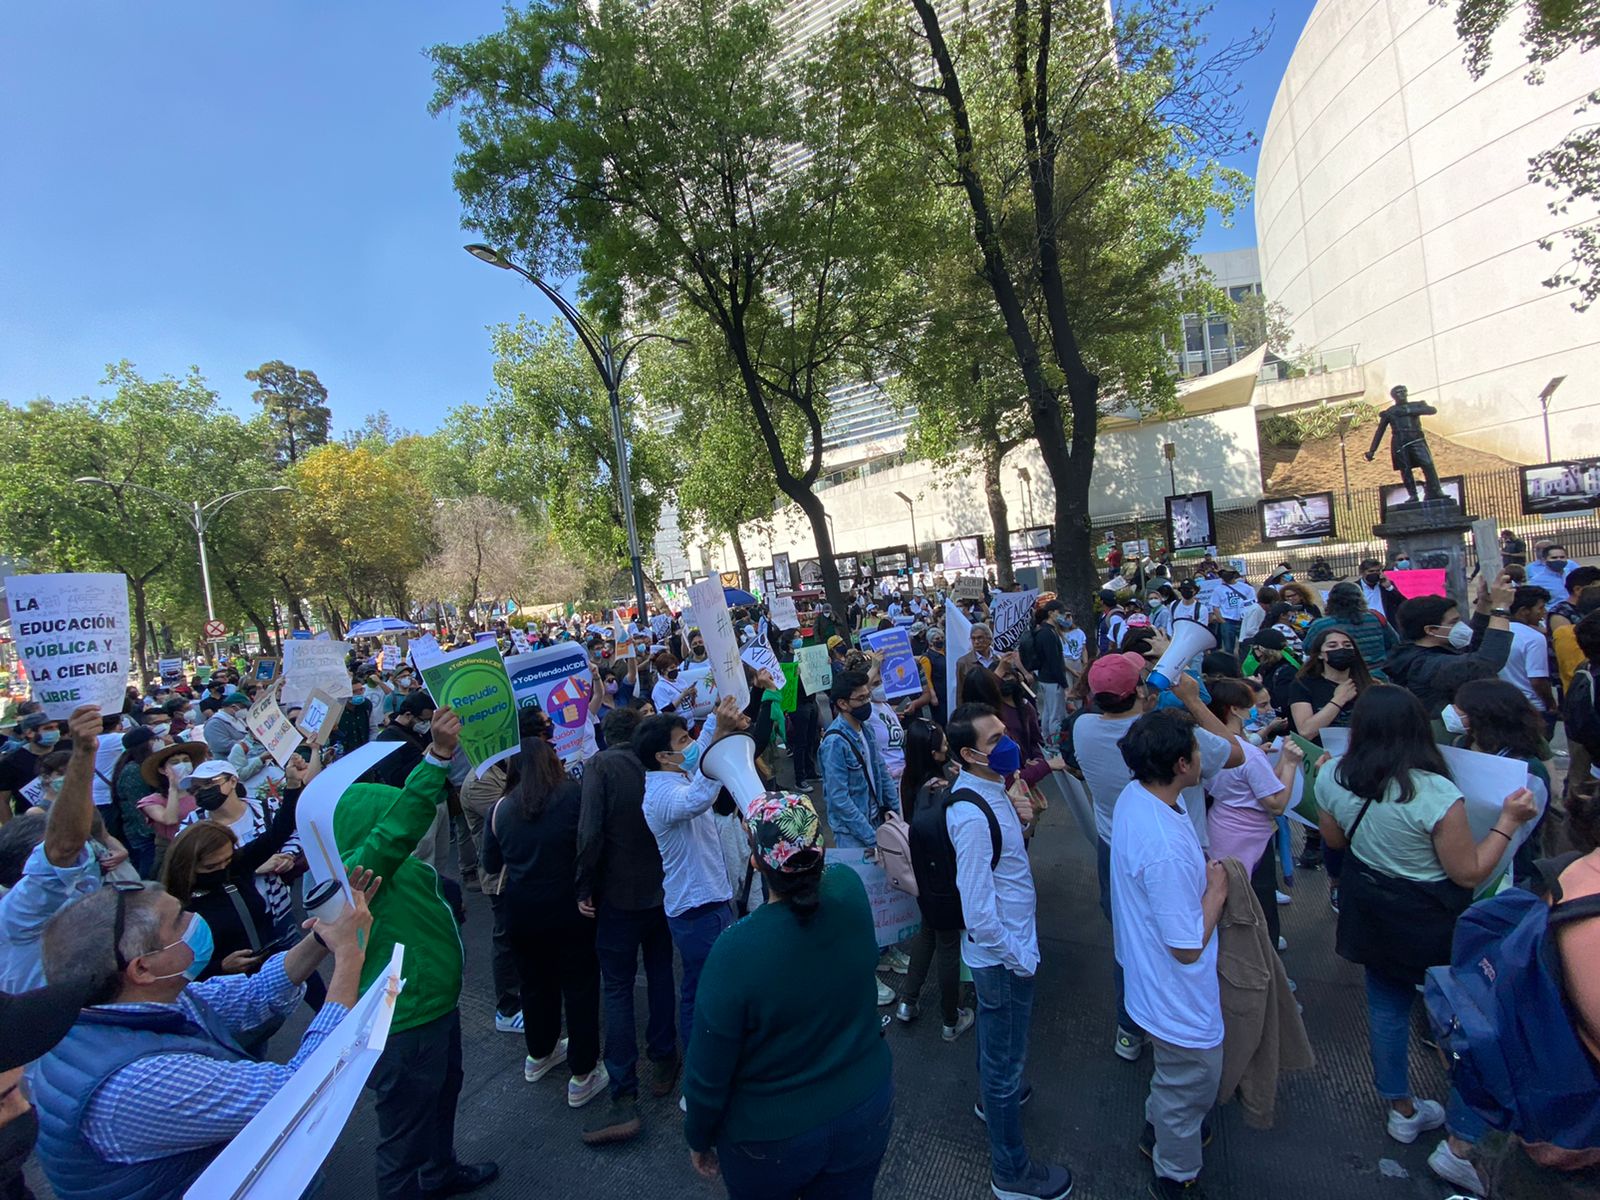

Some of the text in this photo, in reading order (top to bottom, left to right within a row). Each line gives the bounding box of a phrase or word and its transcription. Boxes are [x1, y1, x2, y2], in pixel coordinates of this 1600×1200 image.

[15, 598, 40, 612] LA
[995, 593, 1035, 634] CIENCIA
[20, 613, 116, 636] EDUCACIÓN
[25, 639, 112, 659] PÚBLICA Y
[31, 661, 118, 682] LA CIENCIA
[39, 688, 81, 703] LIBRE
[452, 684, 498, 709] Repudio
[468, 700, 508, 724] espurio
